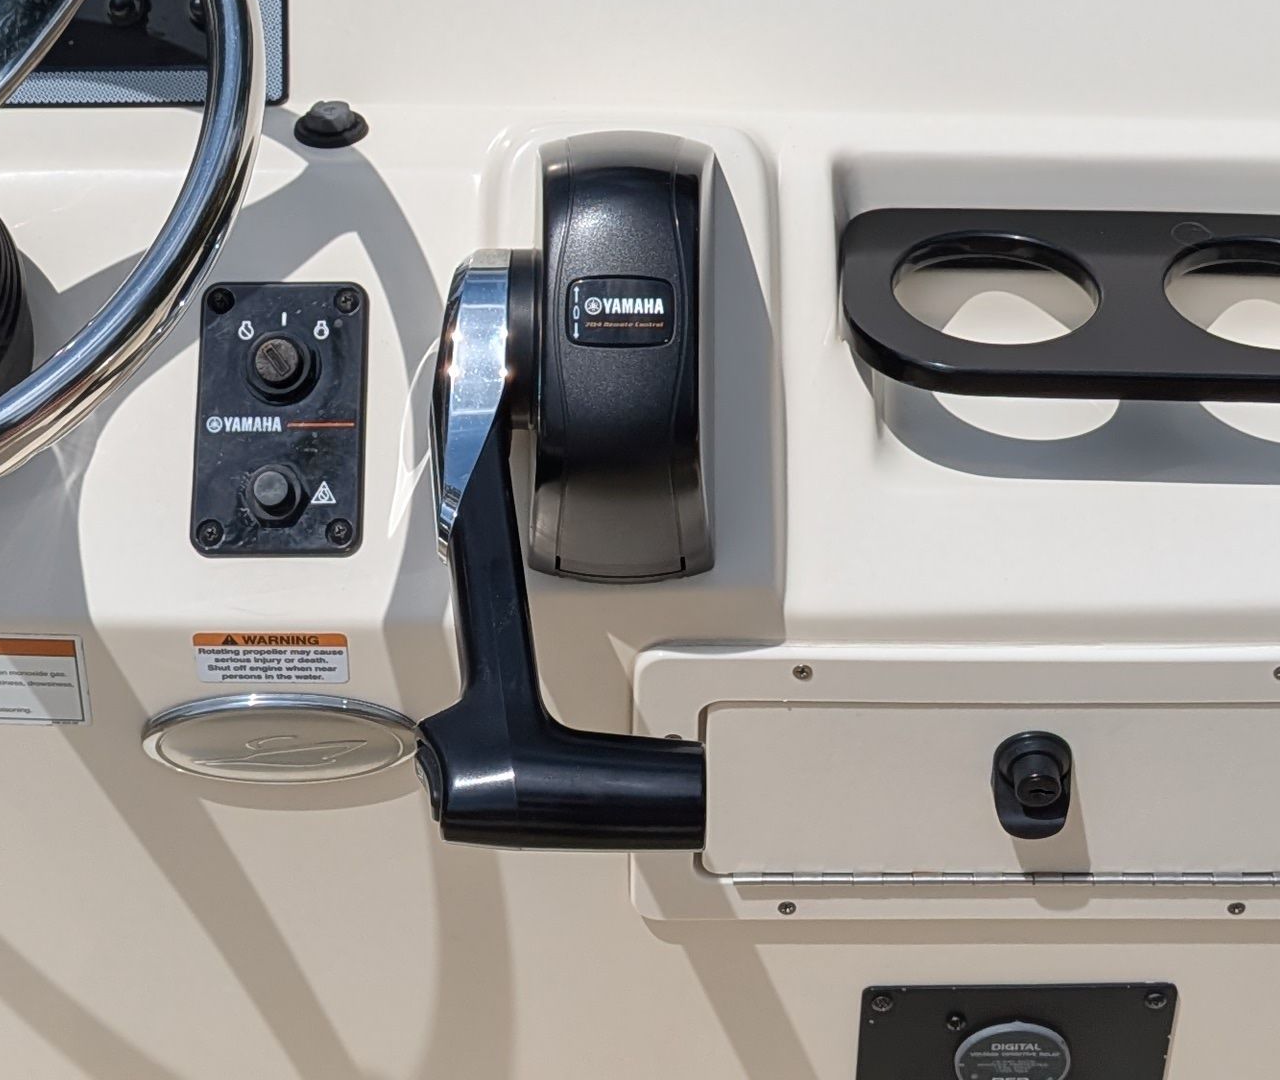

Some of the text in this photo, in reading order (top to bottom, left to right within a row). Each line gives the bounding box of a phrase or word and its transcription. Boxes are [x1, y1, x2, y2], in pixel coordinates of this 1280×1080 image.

[602, 298, 664, 314] YAMAHA
[224, 416, 282, 432] YAMAHA
[242, 636, 319, 645] WARNING
[991, 1043, 1041, 1051] DIGITAL
